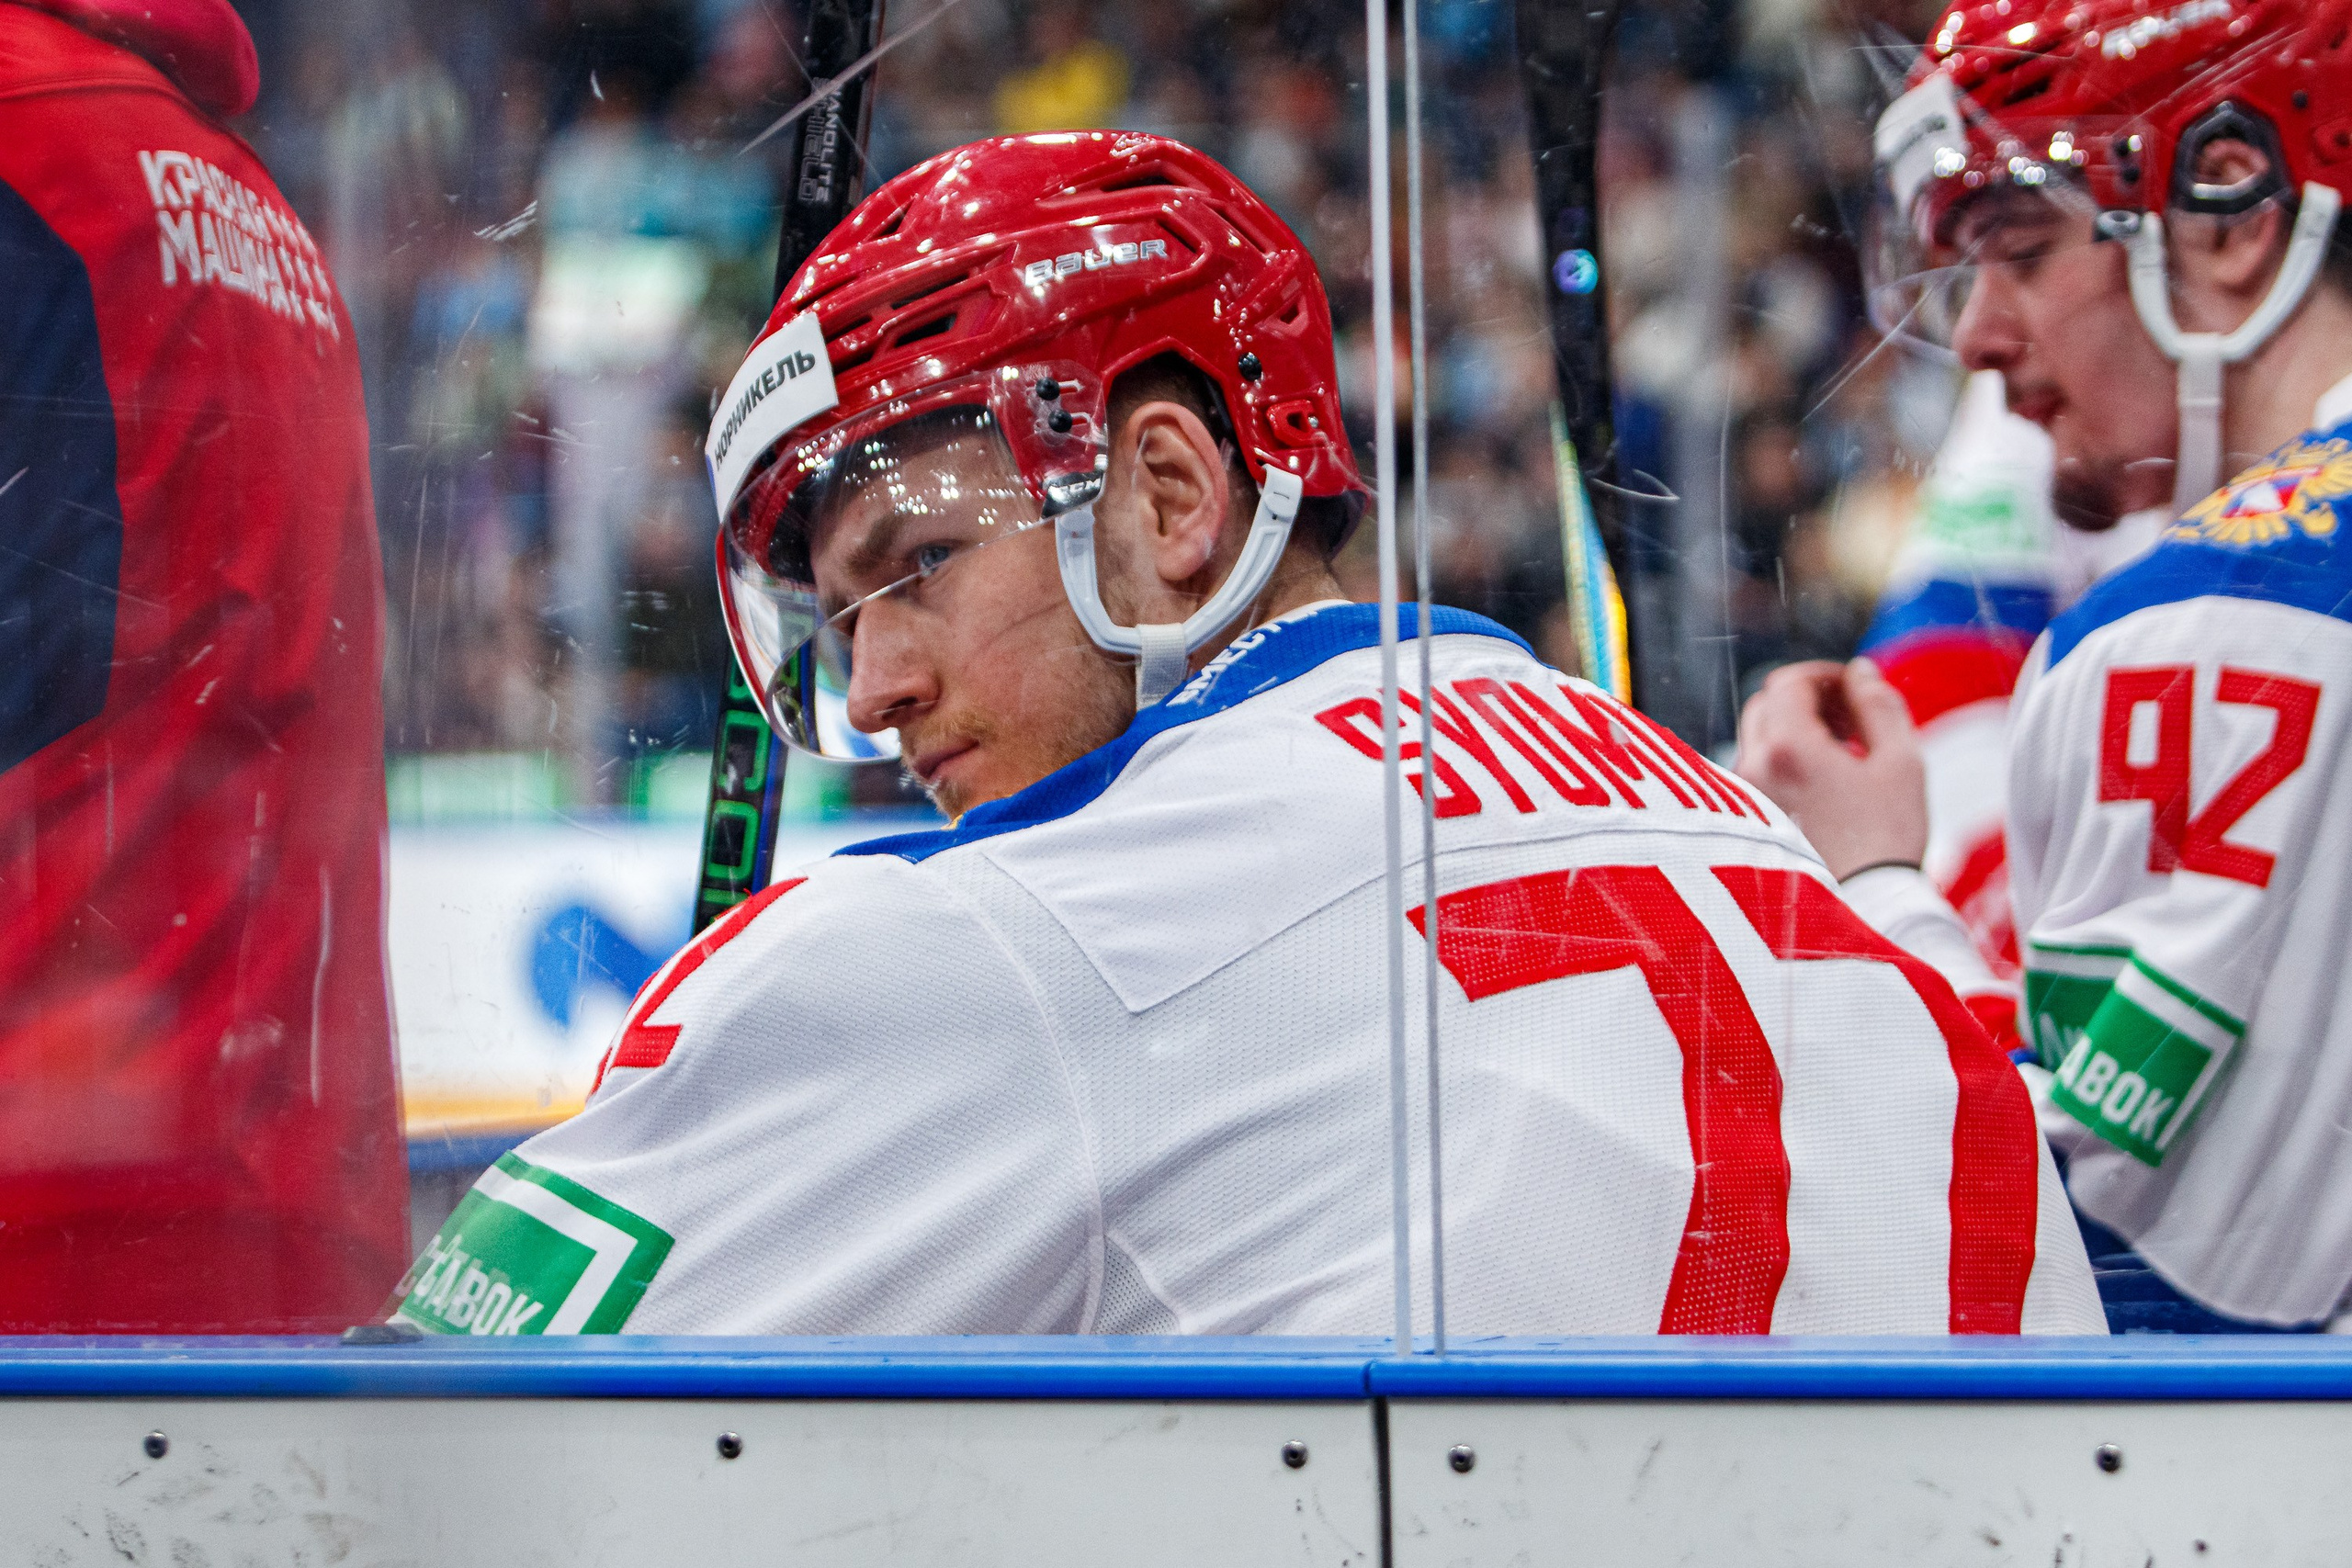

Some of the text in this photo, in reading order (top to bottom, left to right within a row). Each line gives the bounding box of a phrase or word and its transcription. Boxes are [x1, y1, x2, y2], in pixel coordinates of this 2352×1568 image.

[1024, 239, 1170, 288] BAUER
[714, 349, 816, 472] НОРНИКЕЛЬ
[2098, 663, 2323, 888] 92
[1406, 865, 2039, 1335] 77
